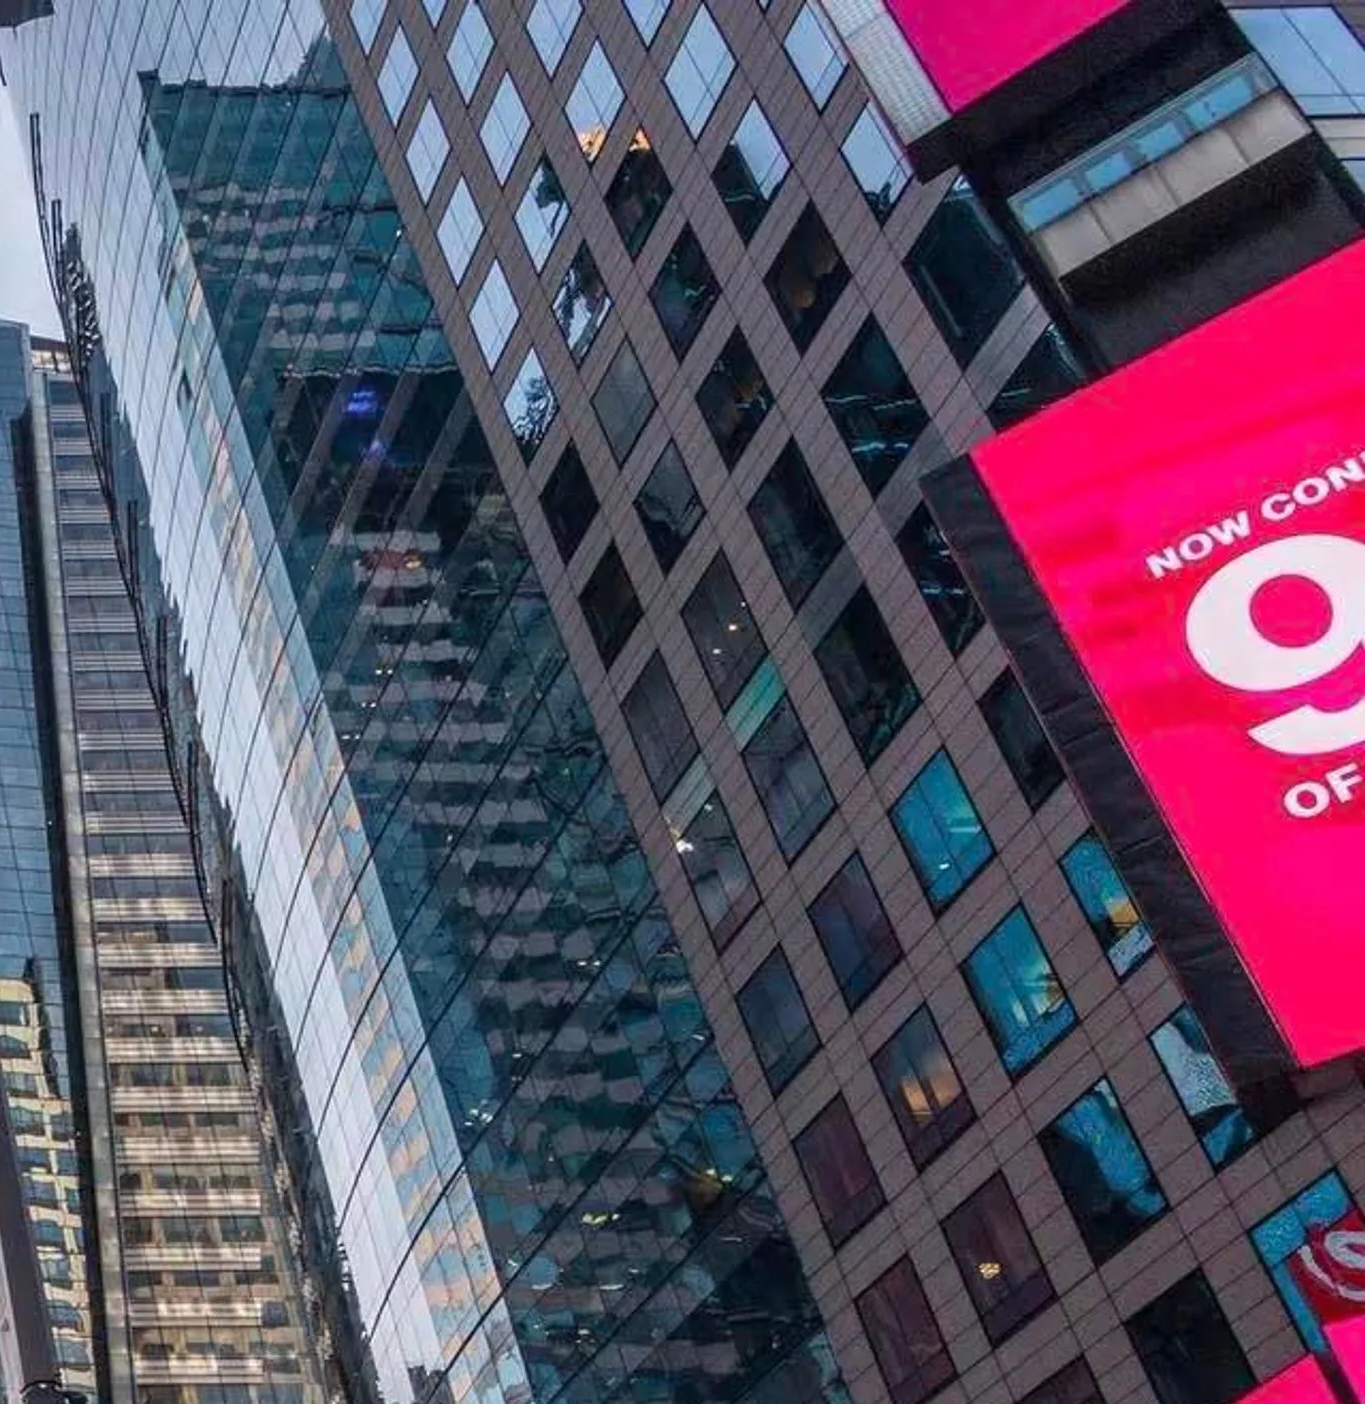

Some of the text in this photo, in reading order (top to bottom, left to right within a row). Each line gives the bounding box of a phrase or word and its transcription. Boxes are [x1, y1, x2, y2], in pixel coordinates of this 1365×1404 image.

[1145, 451, 1365, 579] NOW CON
[1283, 763, 1365, 818] OF
